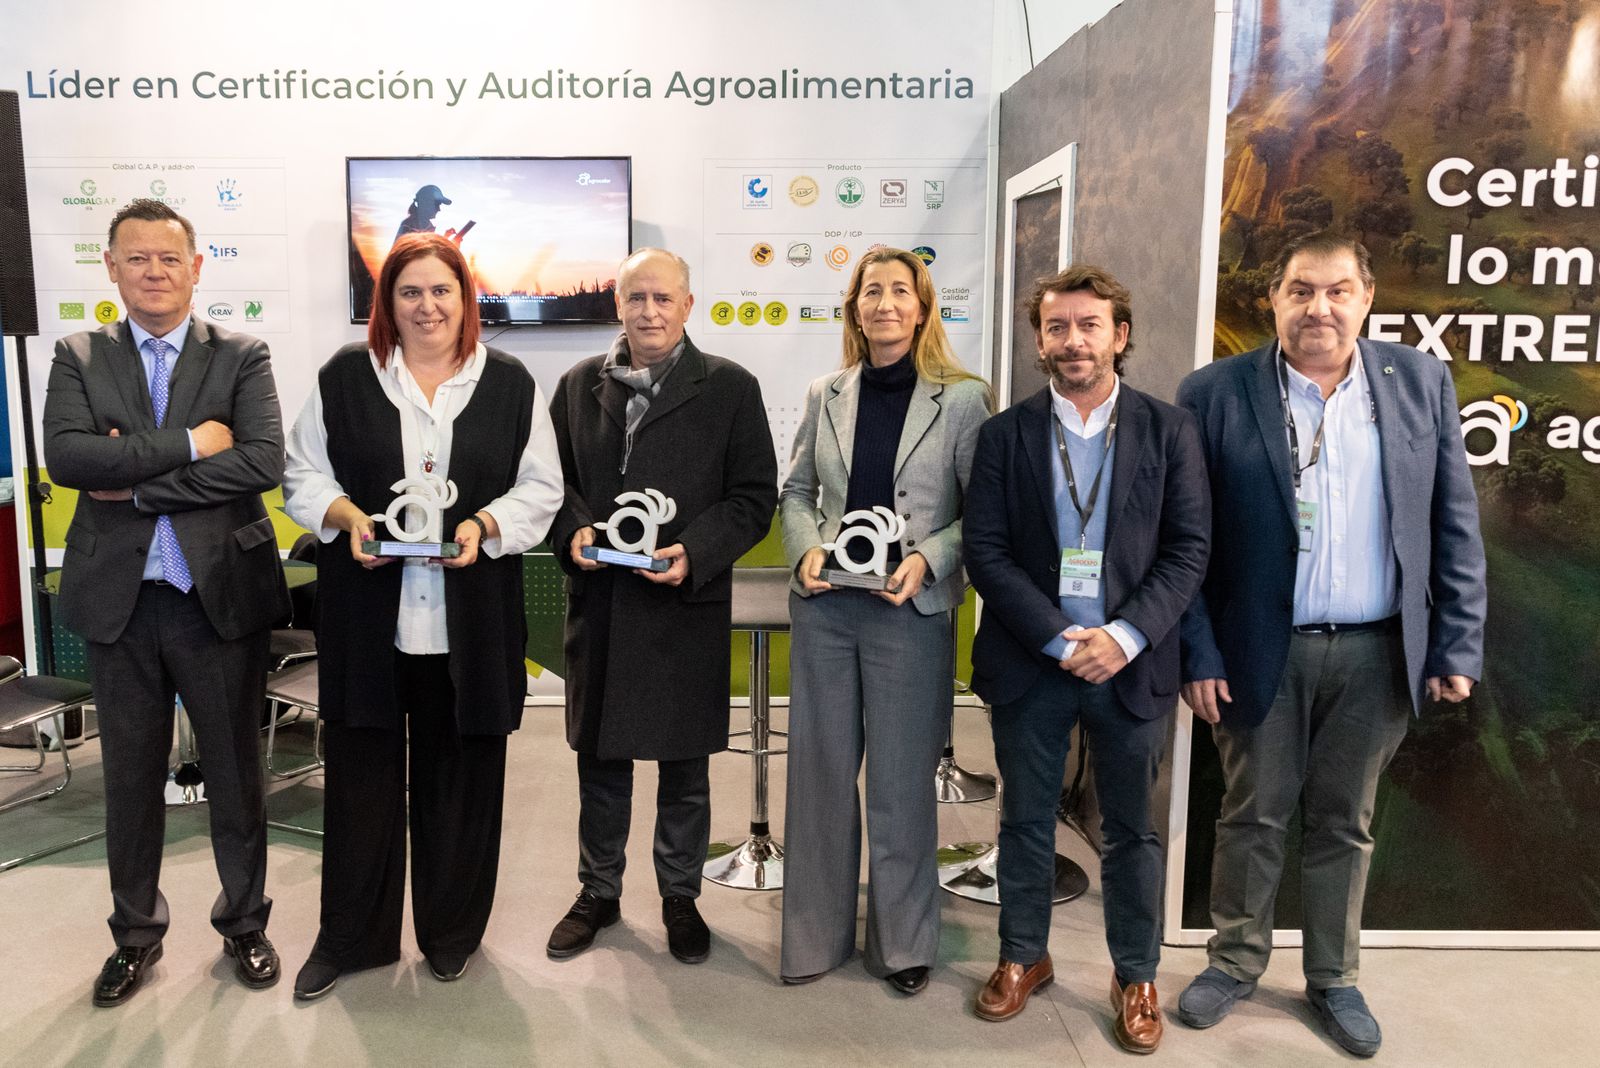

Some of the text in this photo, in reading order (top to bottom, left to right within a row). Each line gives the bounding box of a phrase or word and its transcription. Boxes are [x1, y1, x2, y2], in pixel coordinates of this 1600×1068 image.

[27, 68, 974, 107] Líder en Certificación y Auditoría Agroalimentaria
[220, 248, 238, 257] IFS
[1447, 234, 1600, 285] lo m
[1368, 314, 1600, 362] EXTRE
